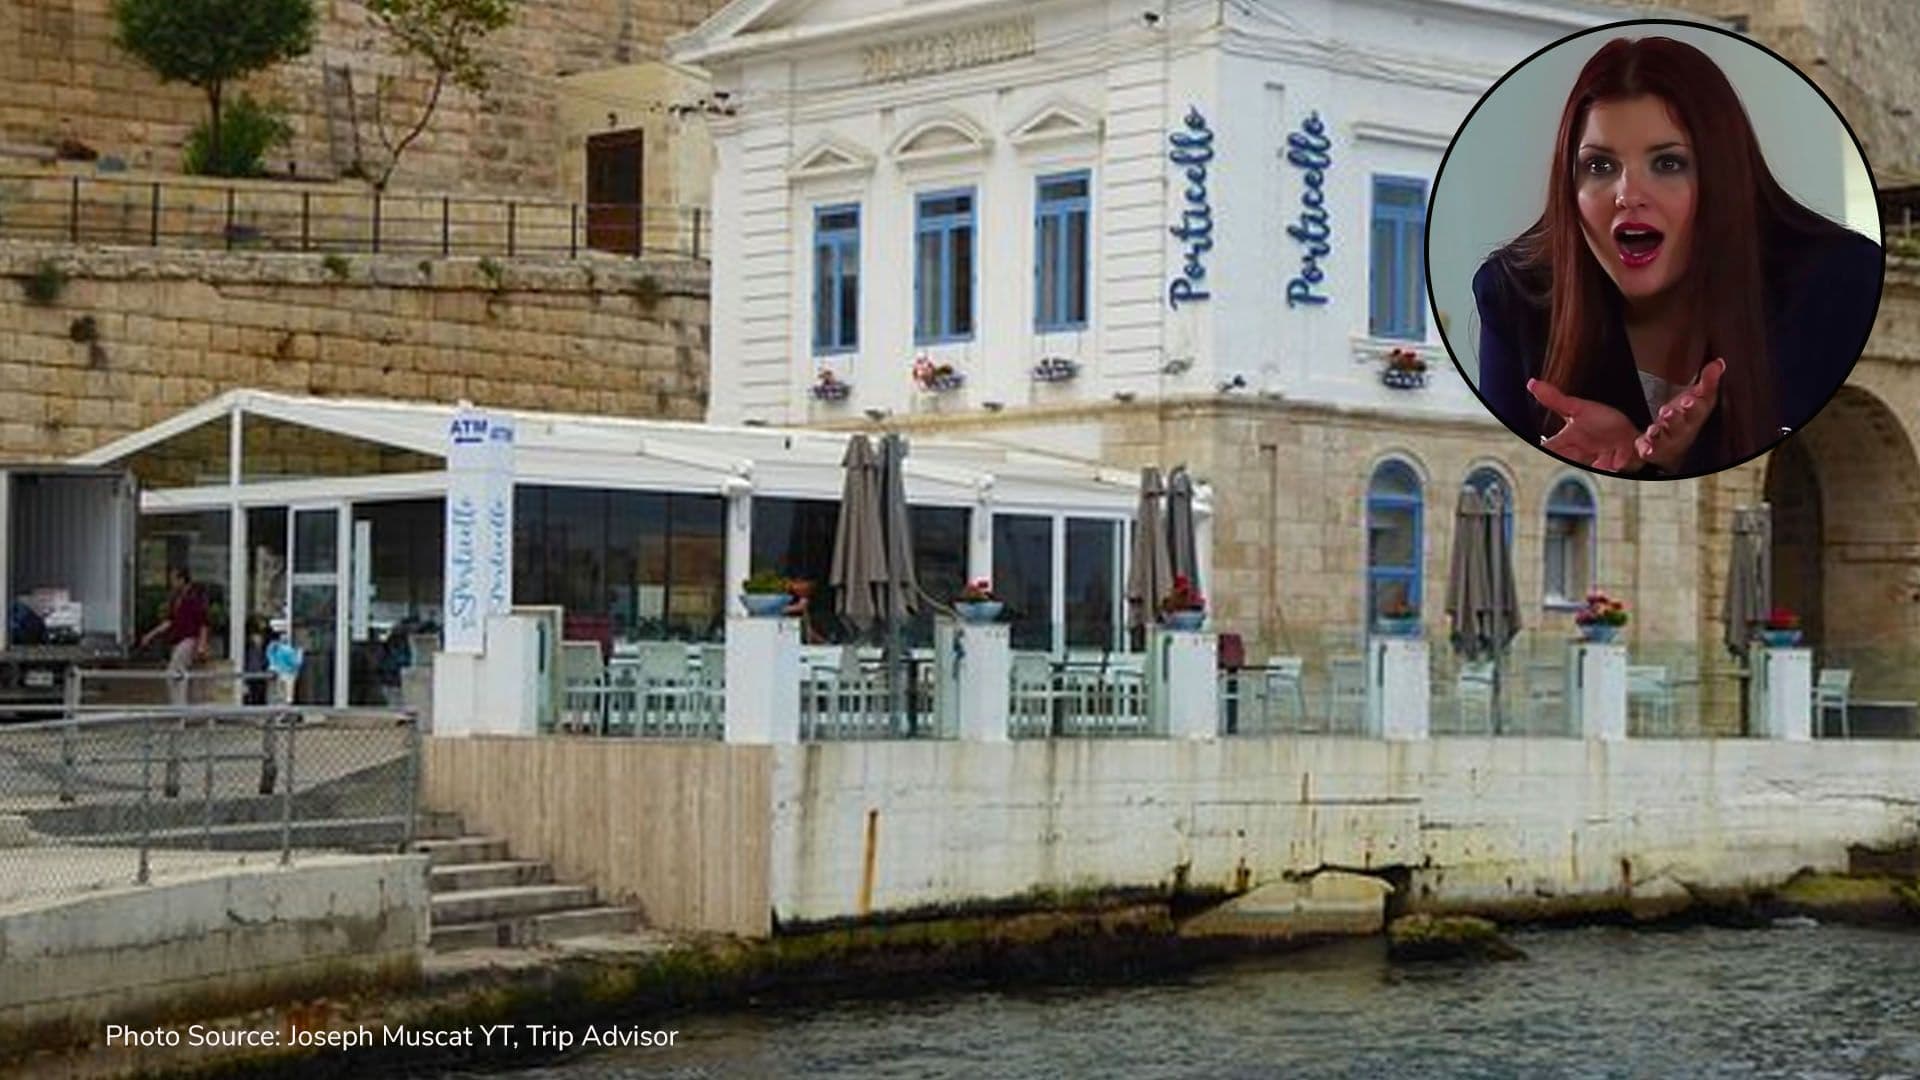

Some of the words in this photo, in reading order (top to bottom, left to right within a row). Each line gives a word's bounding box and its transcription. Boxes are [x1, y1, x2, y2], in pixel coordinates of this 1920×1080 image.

[1168, 105, 1215, 311] Porticello
[1285, 110, 1332, 309] Porticello
[450, 419, 488, 434] ATM
